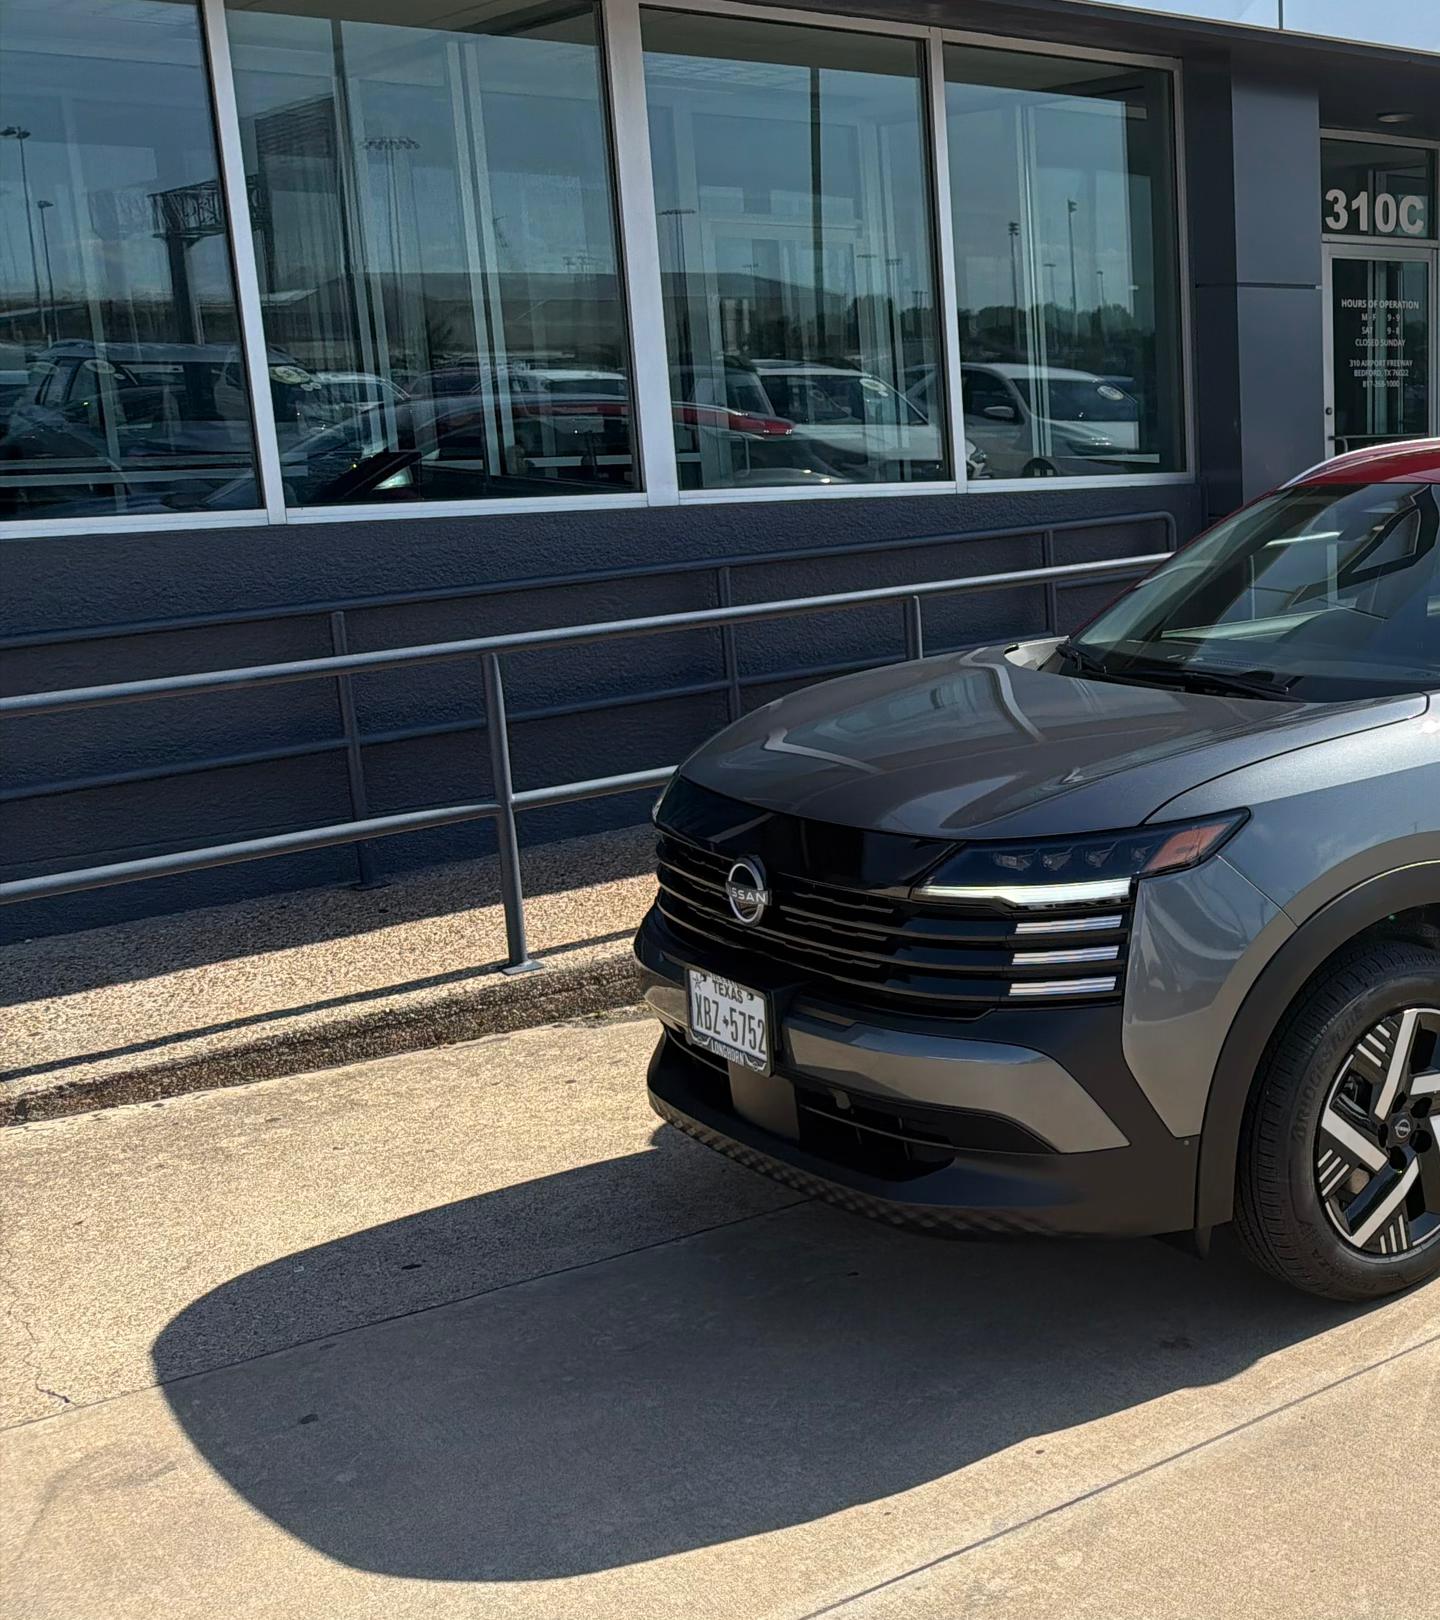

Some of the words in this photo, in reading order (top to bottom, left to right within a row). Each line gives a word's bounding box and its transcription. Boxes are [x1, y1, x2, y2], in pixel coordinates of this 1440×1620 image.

[1325, 189, 1424, 234] 310C
[1341, 299, 1366, 308] HOURS
[1368, 300, 1377, 309] OF
[1379, 300, 1419, 309] OPERATION
[1355, 338, 1379, 347] CLOSED
[1380, 338, 1406, 347] SUNDAY
[1384, 369, 1392, 377] TX
[711, 979, 744, 1004] TEXAS
[729, 1006, 766, 1054] 5752
[711, 1039, 745, 1067] LONGHORN
